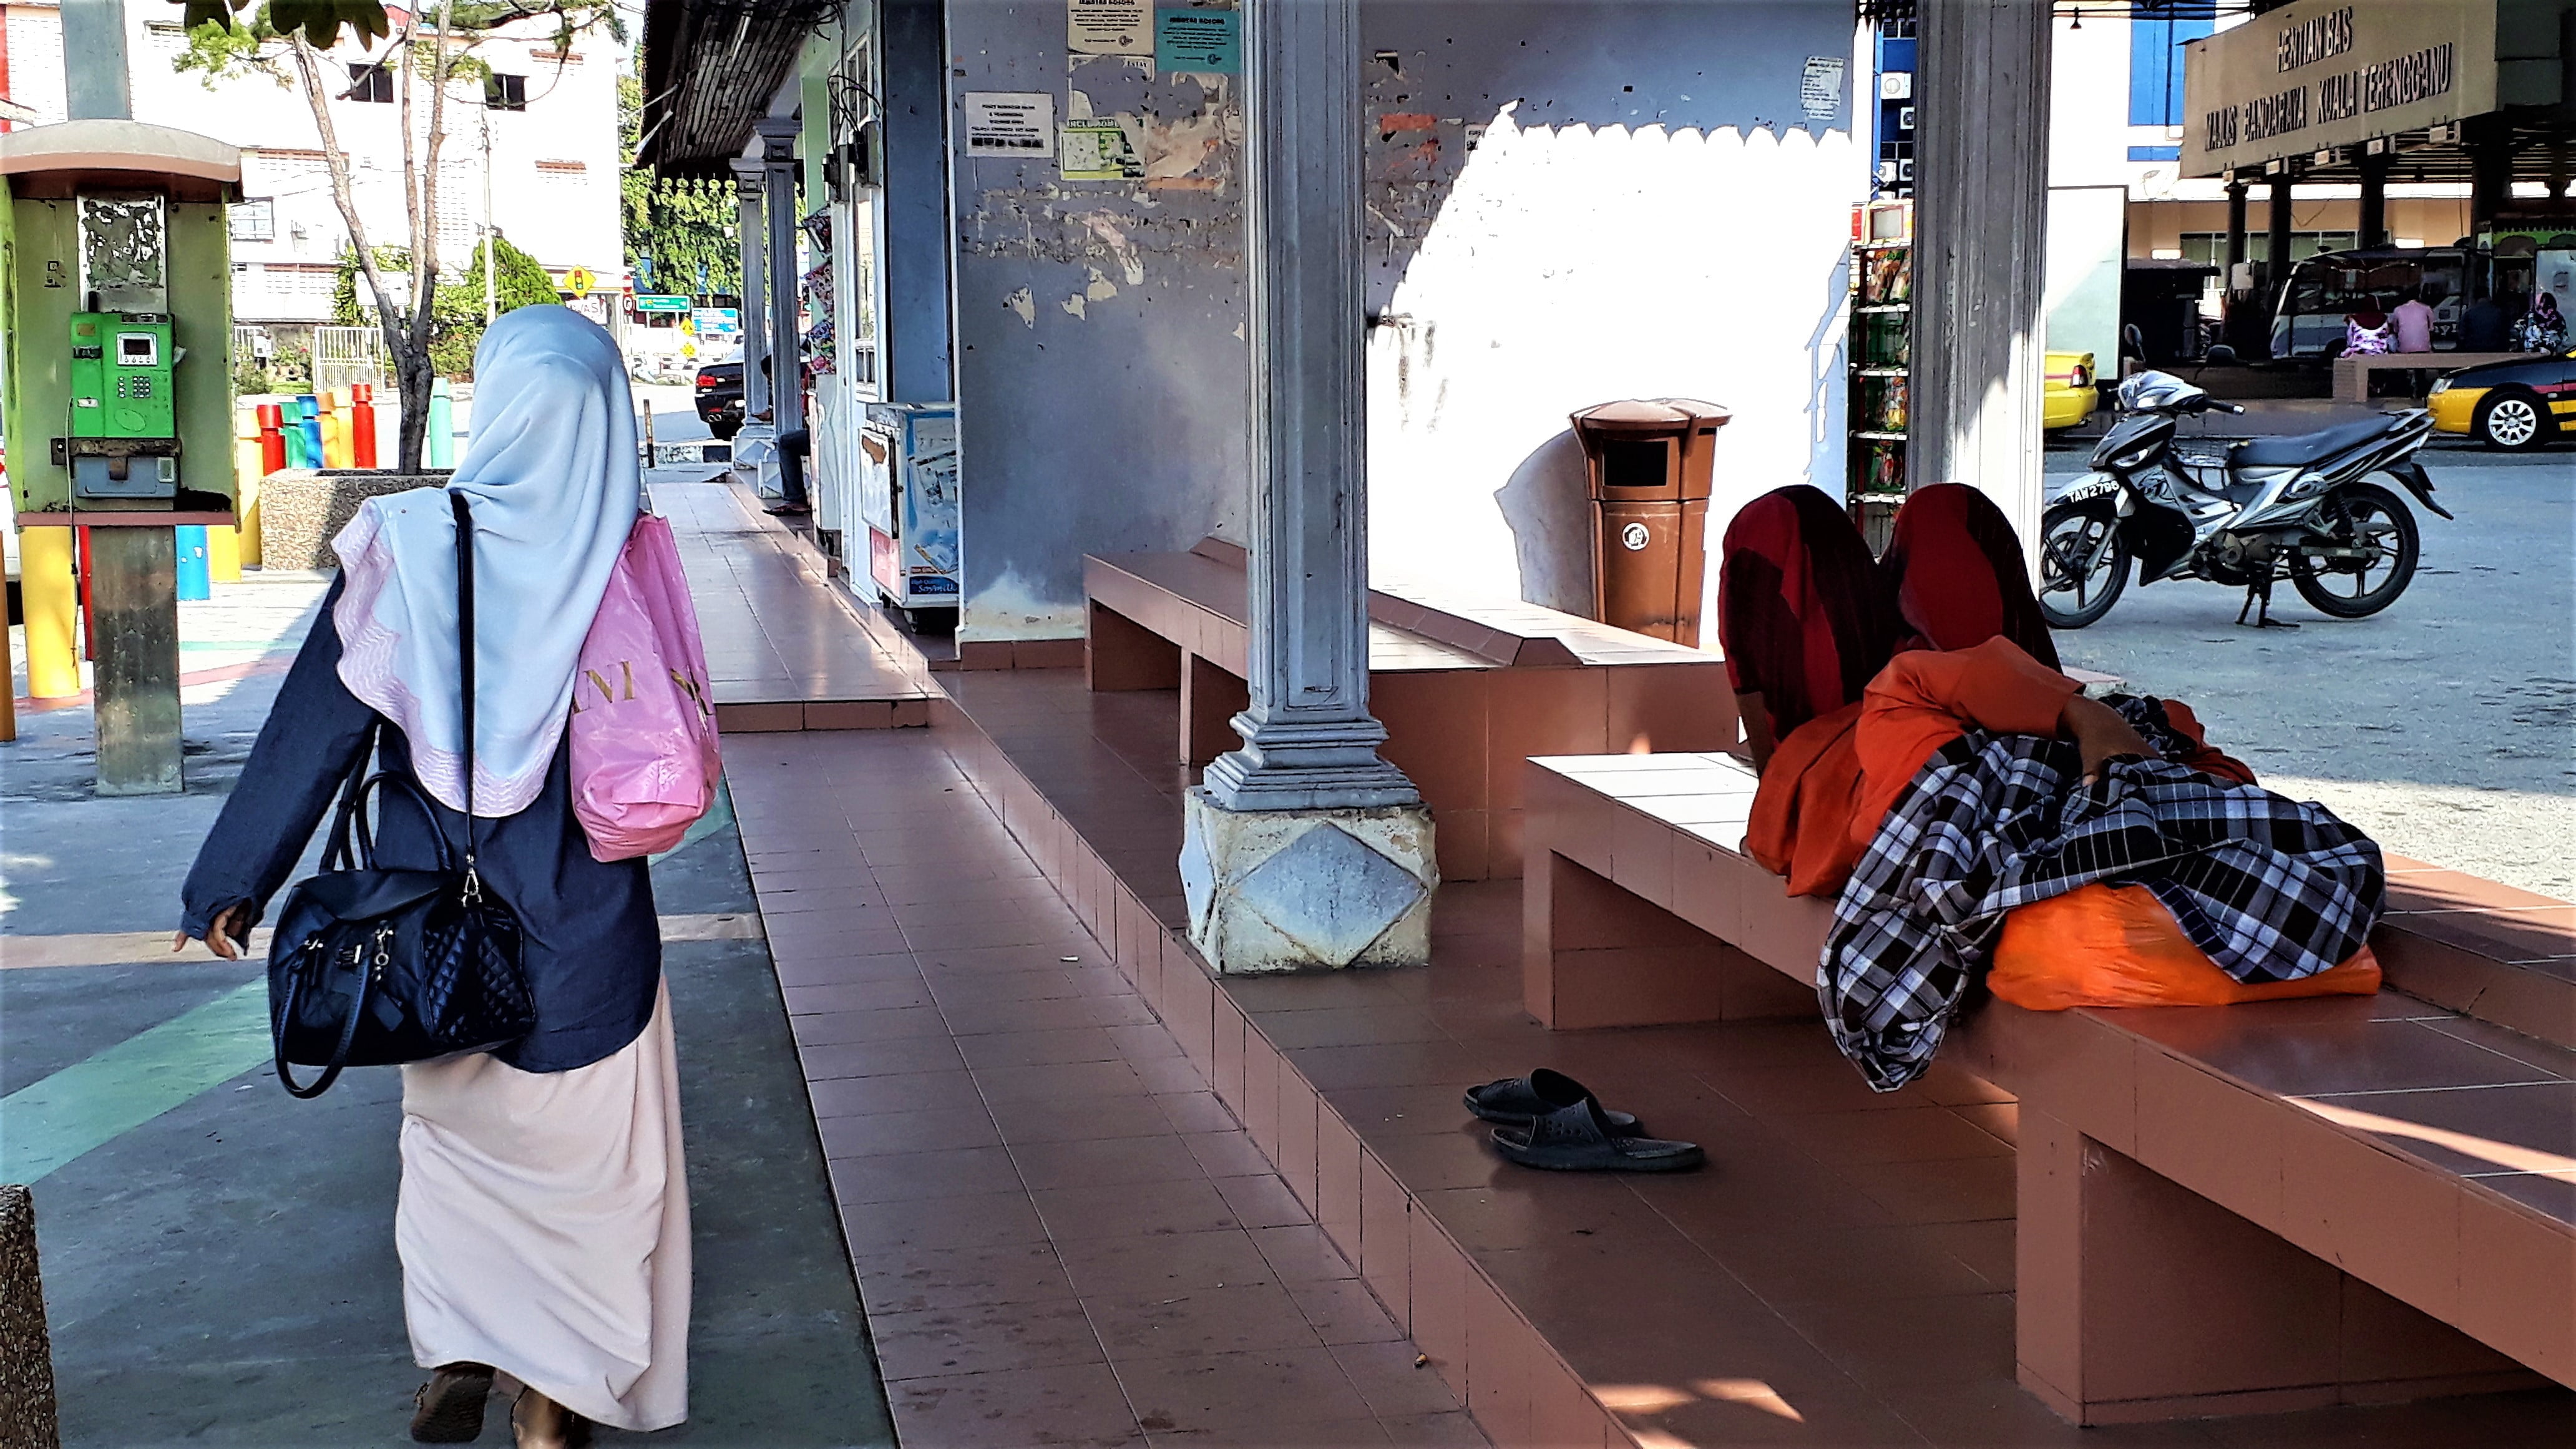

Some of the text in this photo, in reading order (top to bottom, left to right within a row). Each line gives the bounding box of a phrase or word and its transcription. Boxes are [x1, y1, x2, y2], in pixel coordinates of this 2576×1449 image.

[2277, 6, 2353, 73] HENTIAN BAS
[2245, 85, 2308, 142] BANDARAYA
[2317, 71, 2358, 124] KUALA
[2361, 42, 2452, 113] TERENGGANU
